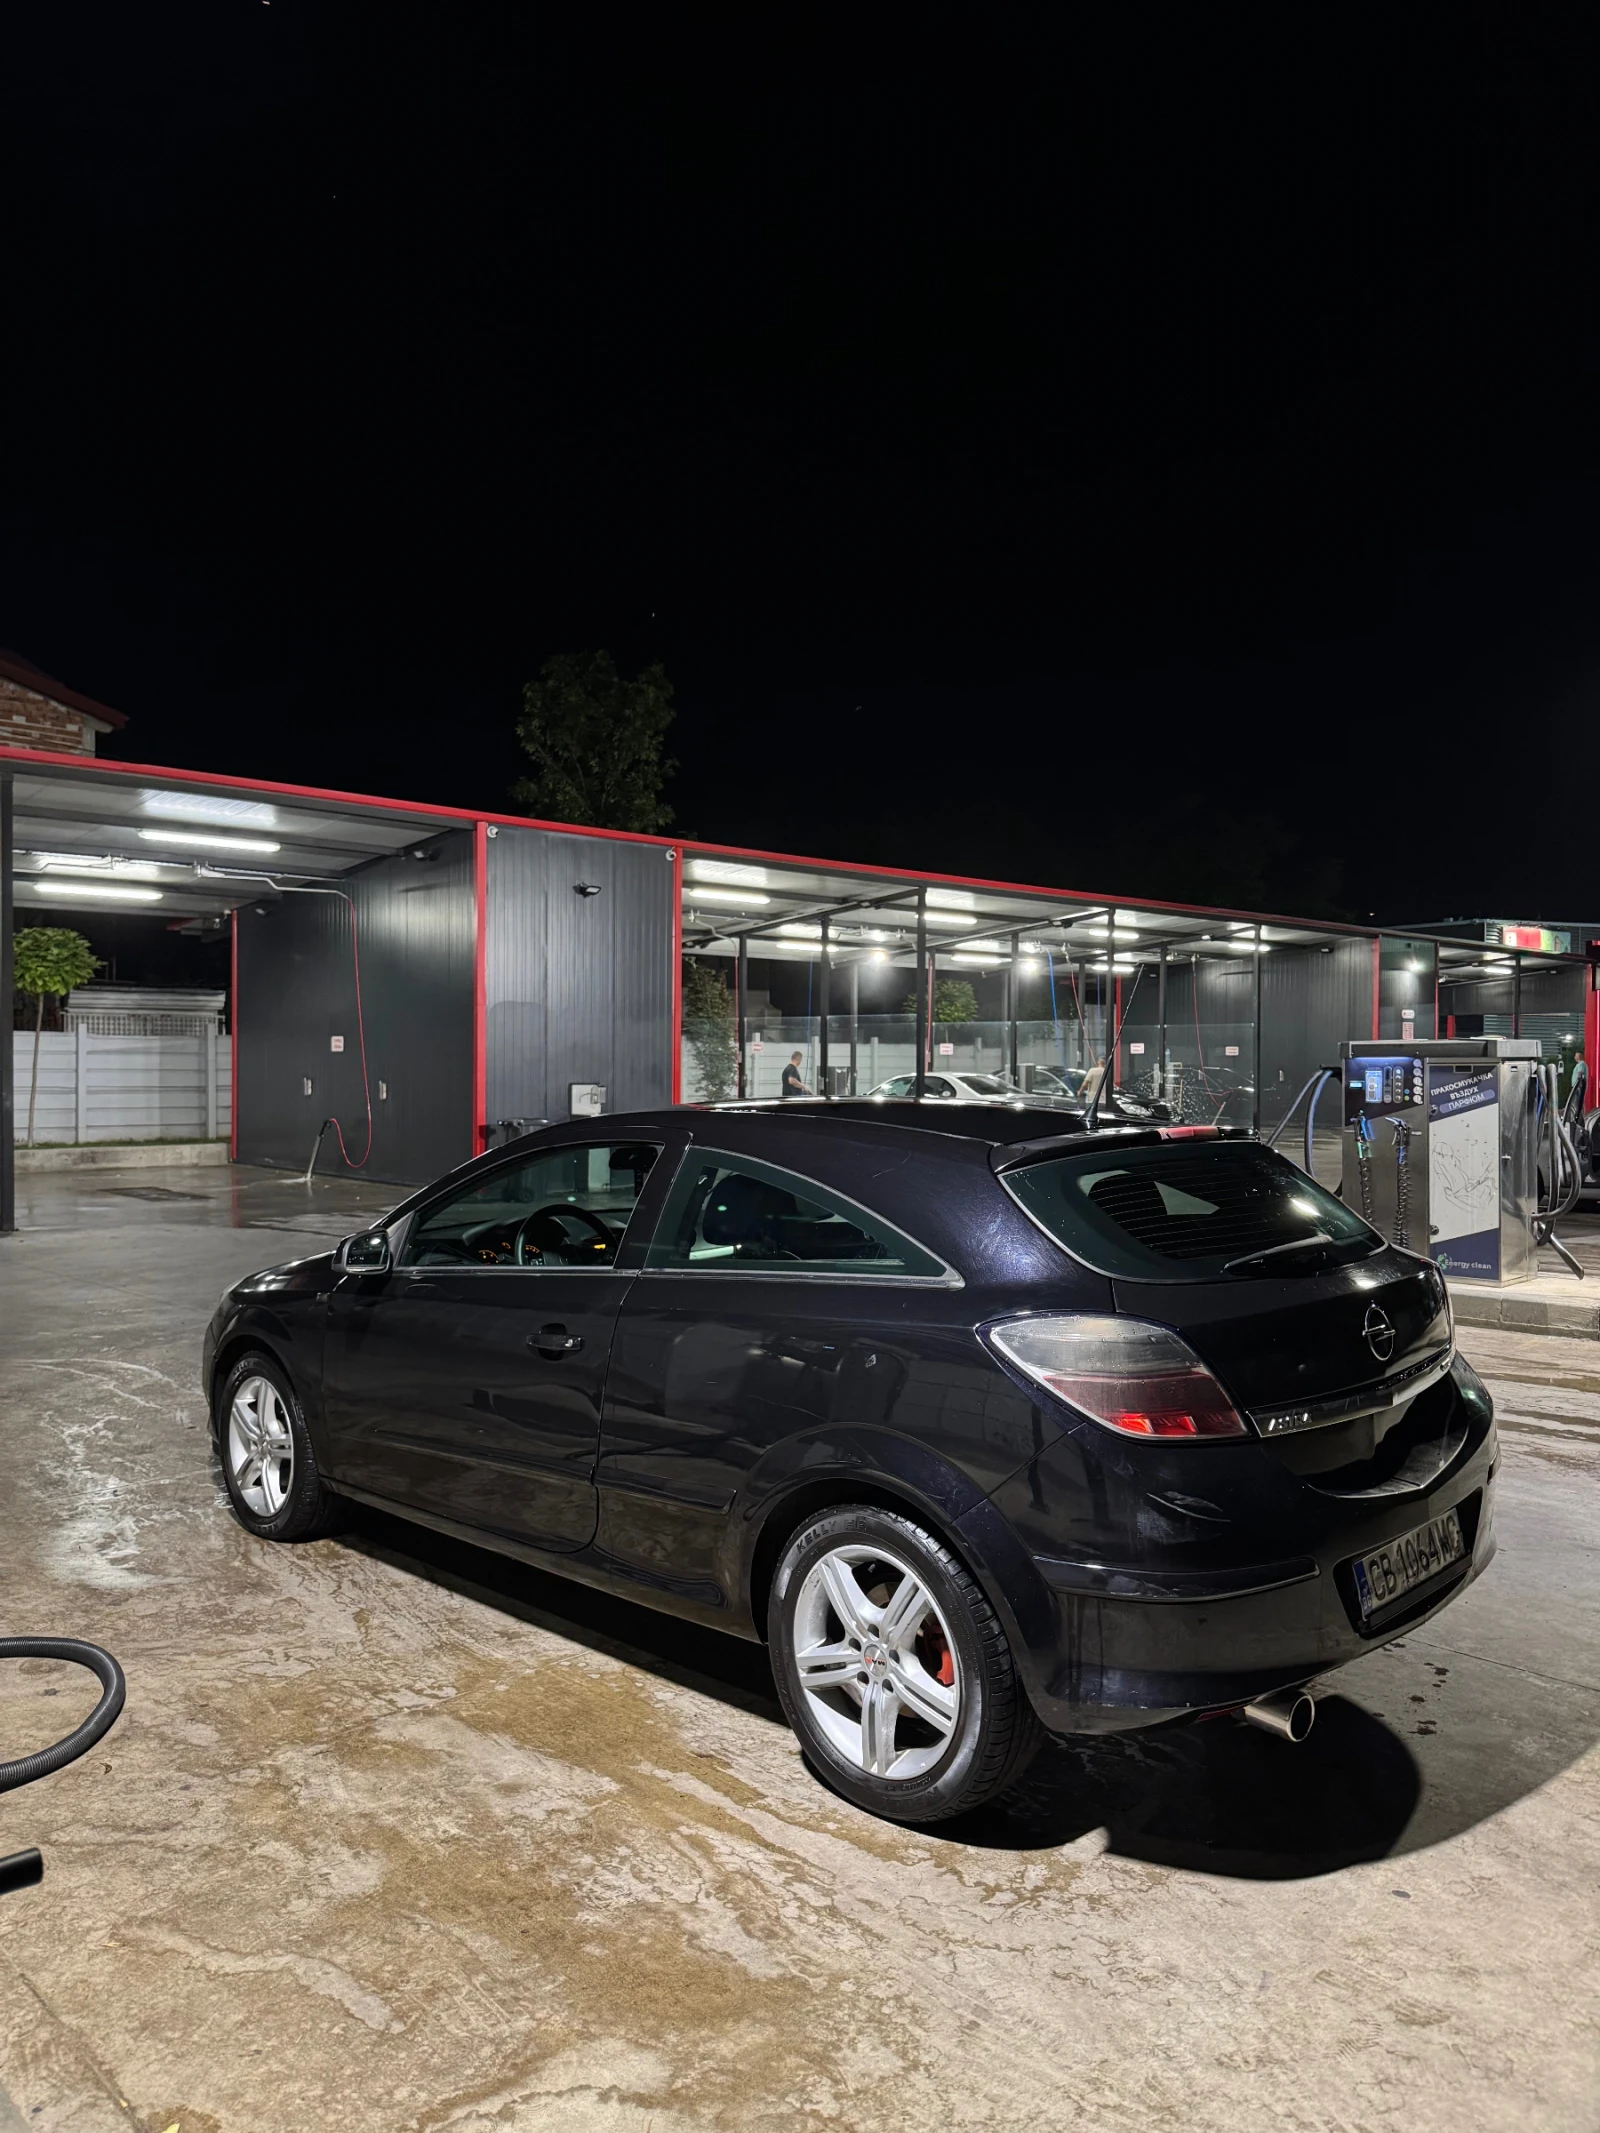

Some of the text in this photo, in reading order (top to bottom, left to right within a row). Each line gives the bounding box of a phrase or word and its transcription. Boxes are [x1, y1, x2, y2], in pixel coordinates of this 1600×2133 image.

[1430, 1072, 1493, 1096] ПРАХОСМУКАЧКА
[1449, 1086, 1479, 1100] ВЪЗДУХ
[1448, 1093, 1485, 1110] ПАРФЮМ
[1444, 1259, 1492, 1270] Energy clean
[796, 1520, 837, 1555] KELLY
[1368, 1552, 1397, 1601] CB
